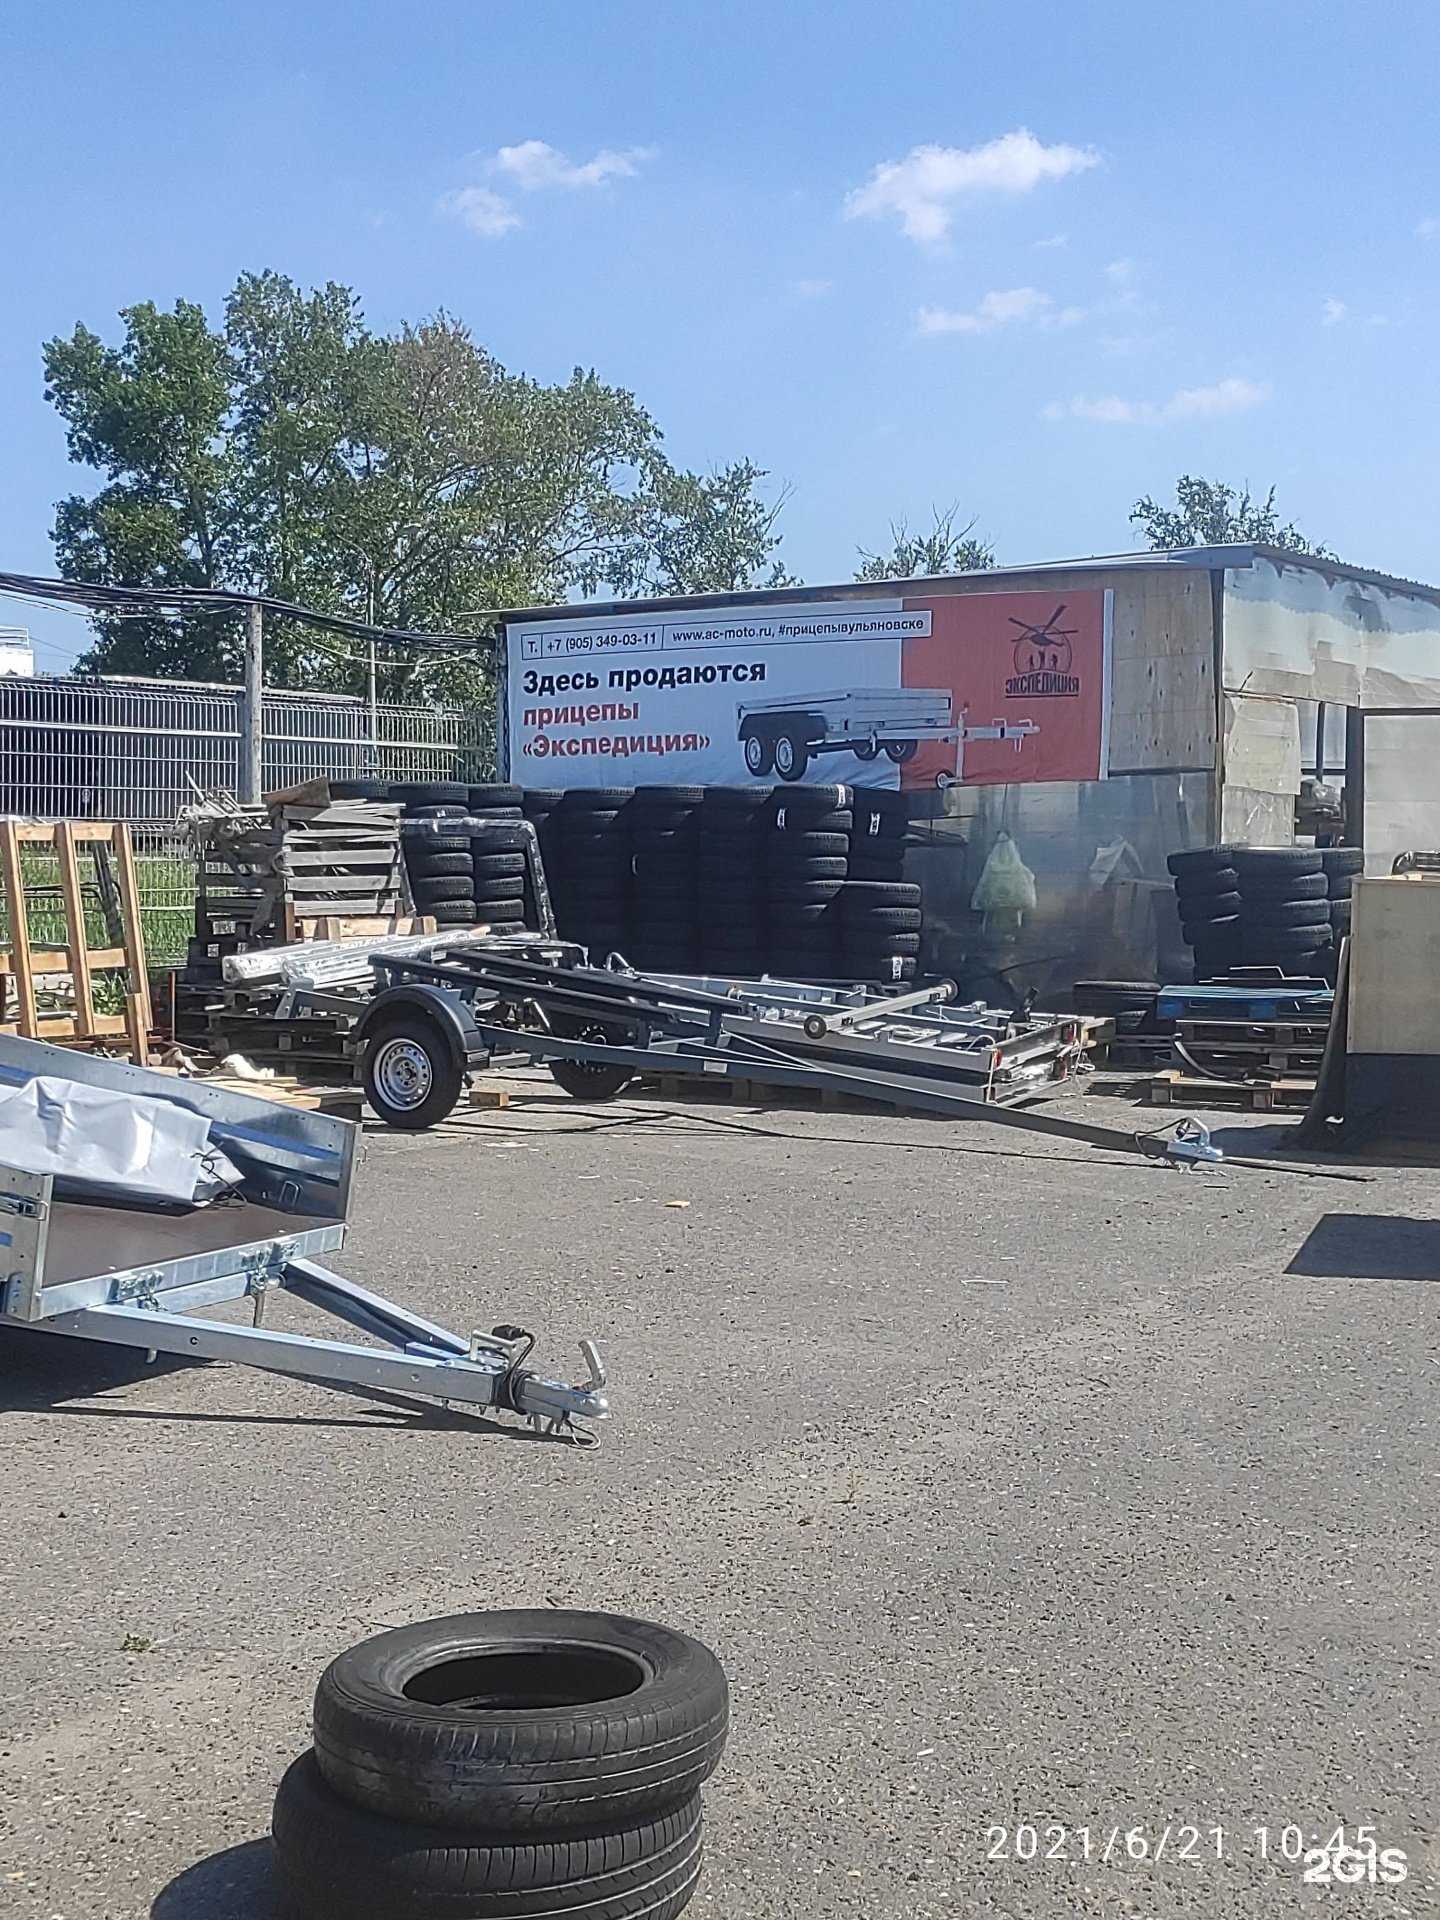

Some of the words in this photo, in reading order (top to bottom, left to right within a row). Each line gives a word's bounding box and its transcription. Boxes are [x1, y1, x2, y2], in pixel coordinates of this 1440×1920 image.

[547, 639, 561, 651] +7
[565, 637, 593, 653] (905)
[596, 633, 656, 648] 349-03-11
[523, 670, 599, 696] Здесь
[608, 663, 766, 691] продаются
[1006, 672, 1079, 694] ЭКСПЕДИЦИЯ
[523, 703, 639, 729] прицепы
[523, 733, 710, 758] «Экспедиция»
